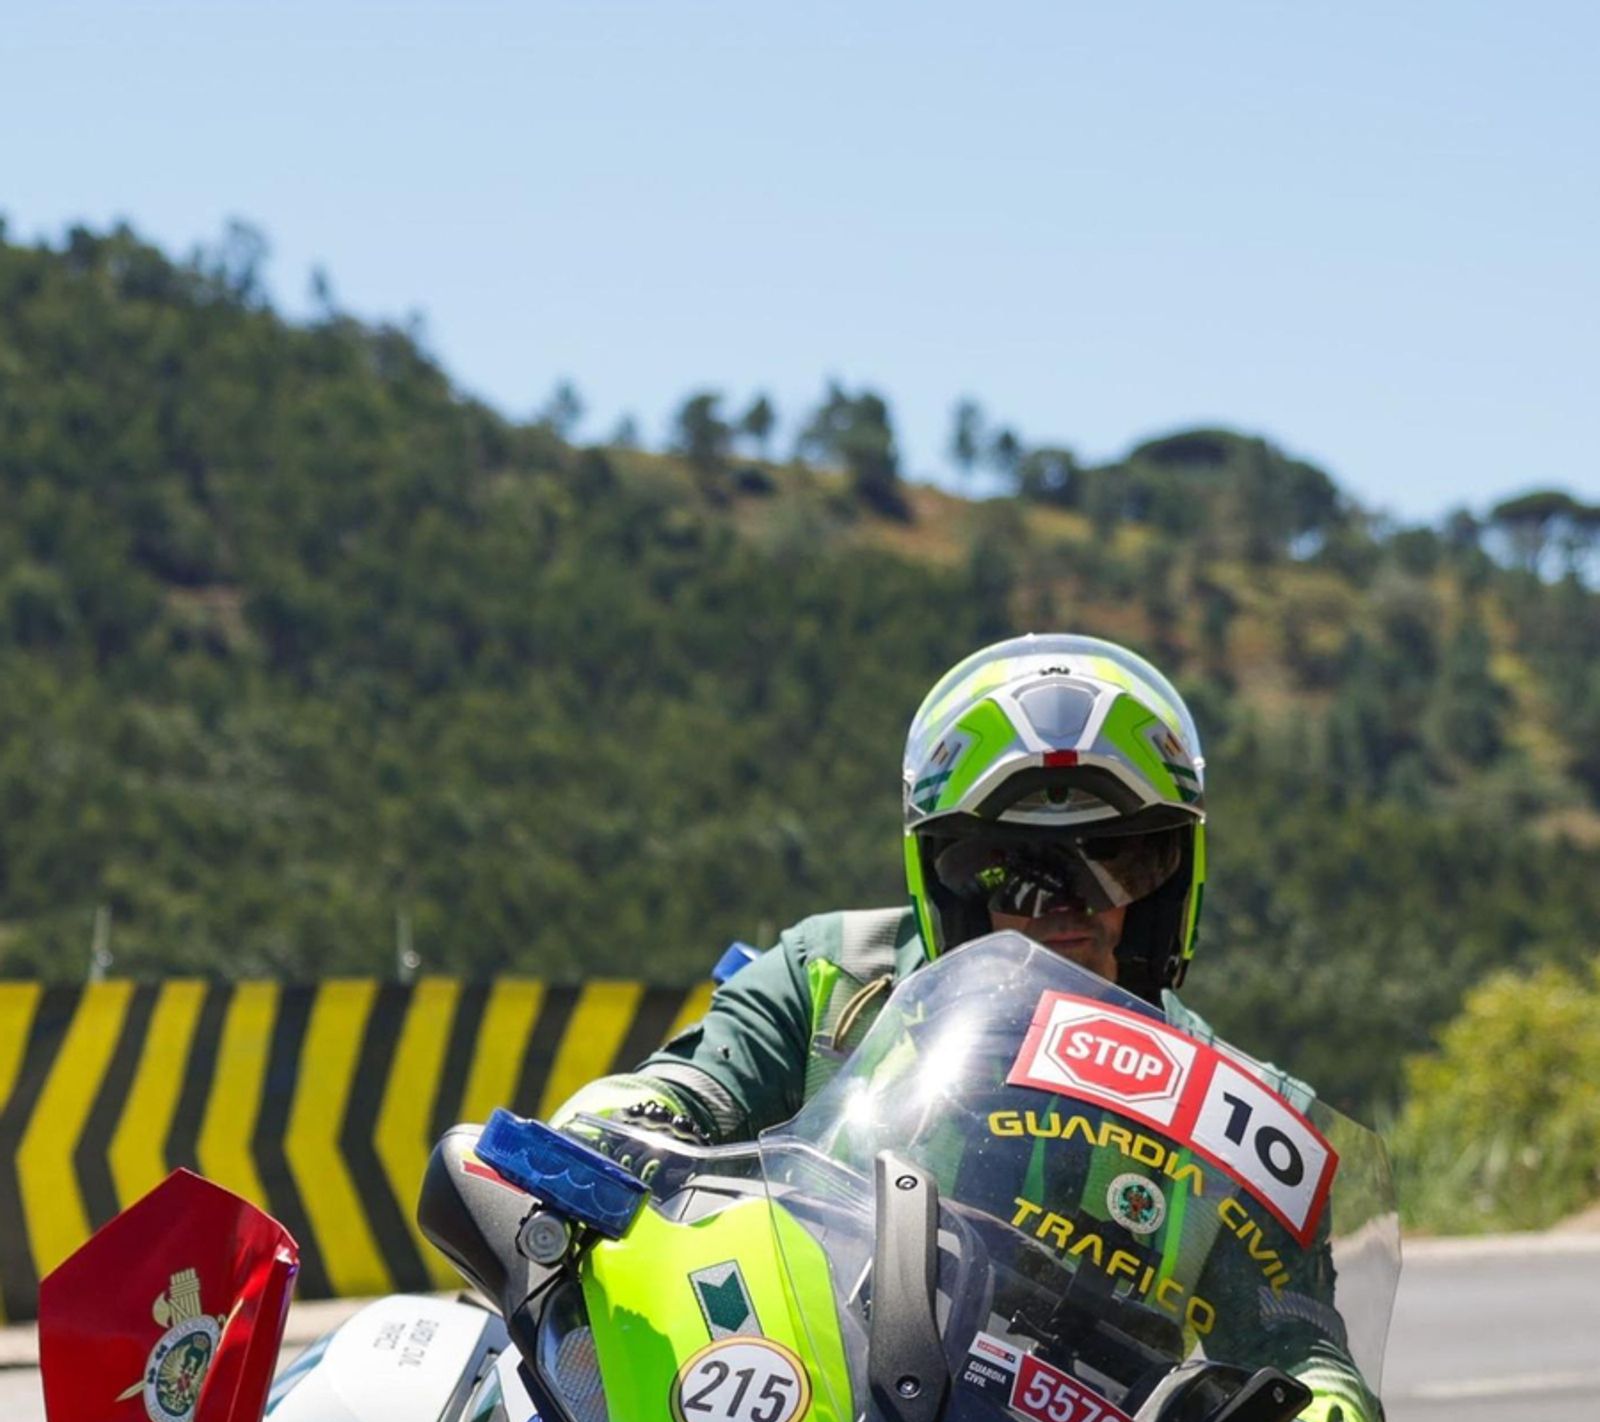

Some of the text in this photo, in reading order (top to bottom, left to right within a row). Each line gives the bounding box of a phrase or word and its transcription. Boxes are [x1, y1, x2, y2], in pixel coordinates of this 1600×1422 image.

[1066, 1031, 1304, 1187] STOP 10
[987, 1110, 1205, 1196] GUARDIA
[1217, 1197, 1291, 1298] CIVIL
[1010, 1196, 1216, 1334] TRAFICO
